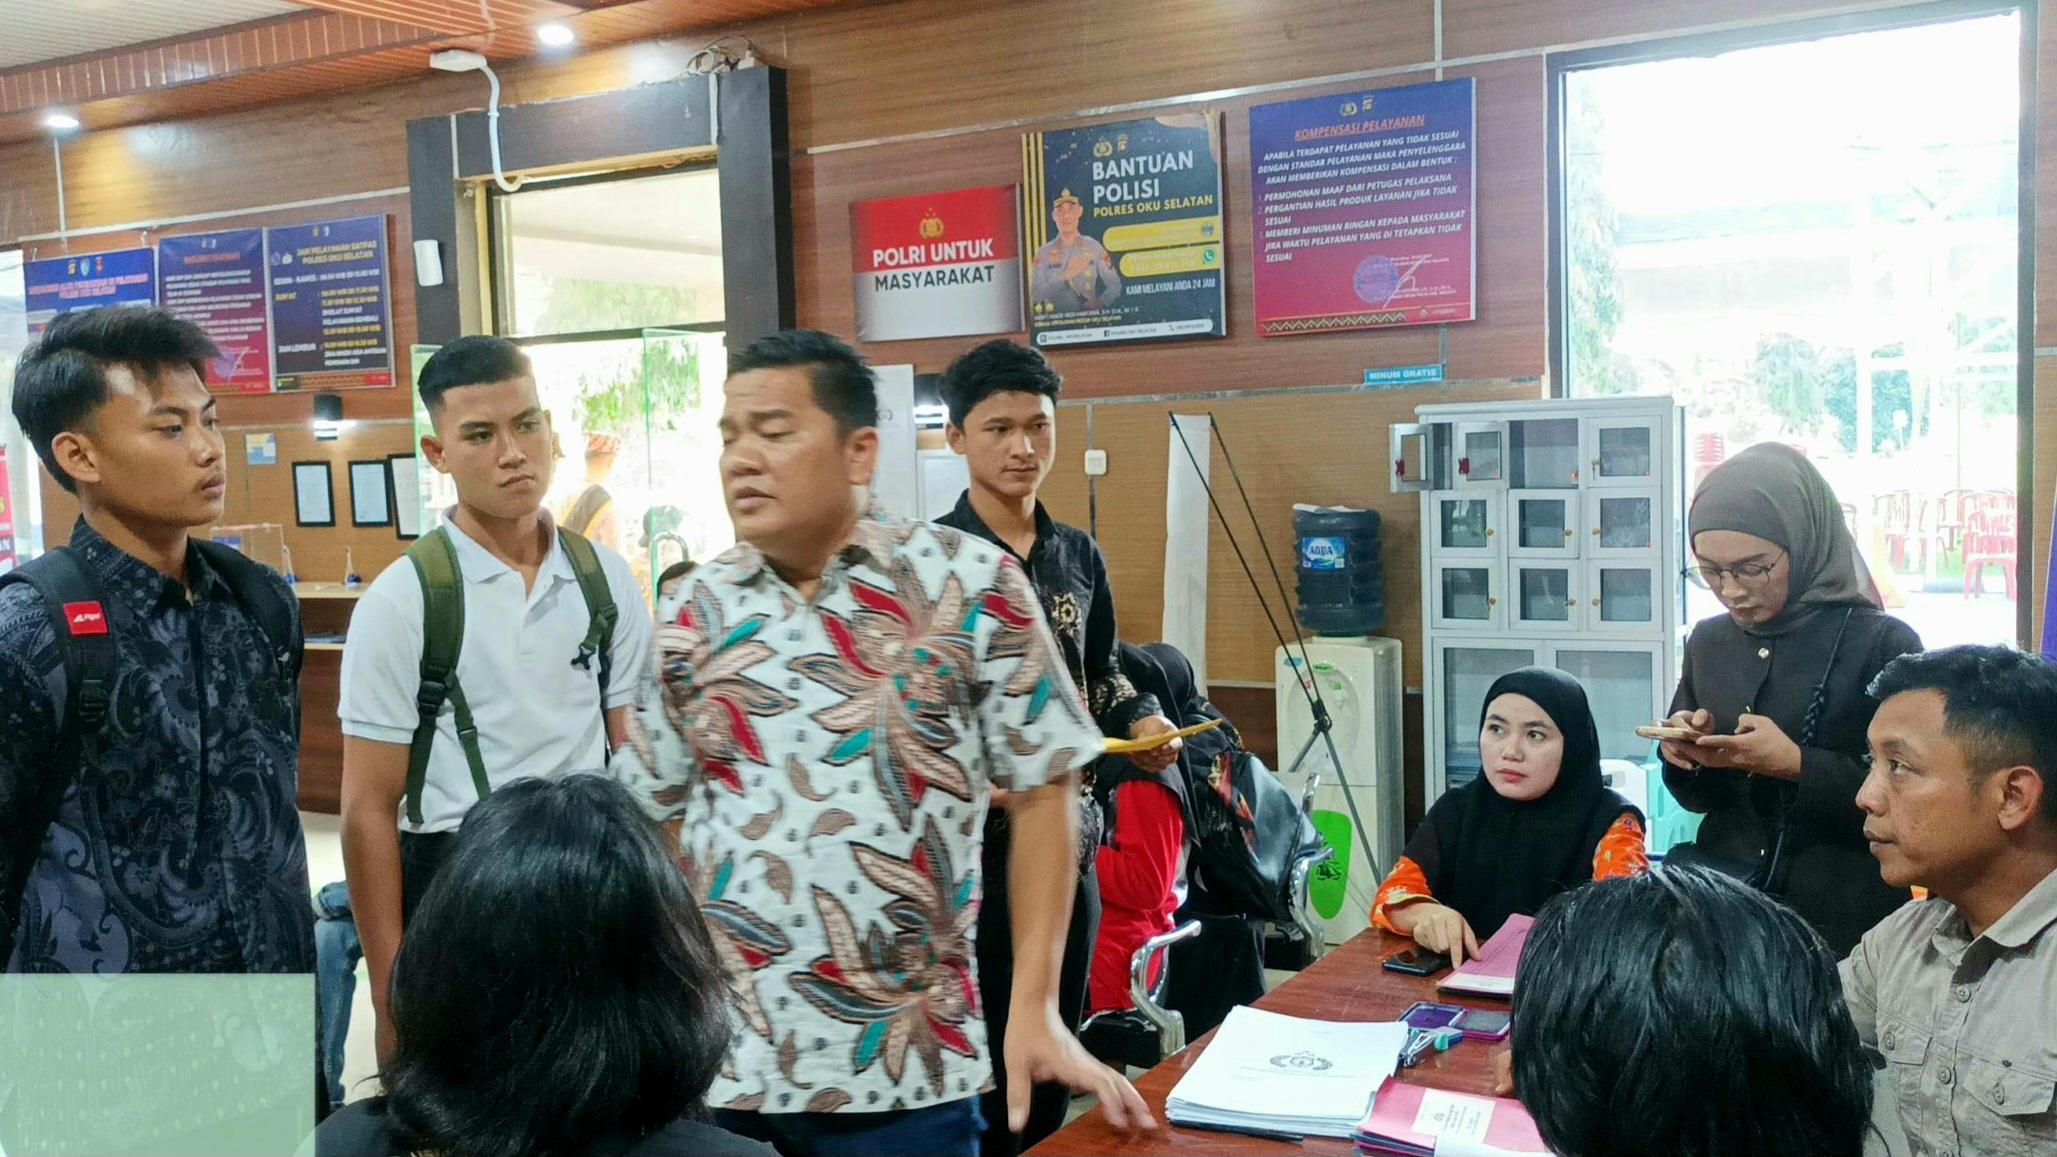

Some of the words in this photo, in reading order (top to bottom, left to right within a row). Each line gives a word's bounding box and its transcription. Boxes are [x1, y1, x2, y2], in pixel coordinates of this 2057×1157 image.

[1295, 123, 1361, 141] KOMPENSASI
[1362, 115, 1425, 132] PELAYANAN
[1258, 163, 1290, 174] DENGAN
[1291, 159, 1325, 170] STANDAR
[1327, 153, 1372, 166] PELAYANAN
[1374, 150, 1396, 159] MAKA
[1398, 142, 1466, 157] PENYELENGGARA
[1264, 150, 1294, 161] APABILA
[1296, 145, 1334, 157] TERDAPAT
[1335, 140, 1380, 152] PELAYANAN
[1382, 137, 1404, 147] YANG
[1406, 134, 1429, 143] TIDAK
[1431, 130, 1459, 140] SESUAI
[1092, 149, 1194, 181] BANTUAN
[1266, 176, 1286, 185] AKAN
[1288, 170, 1338, 182] MEMBERIKAN
[1340, 164, 1389, 177] KOMPENSASI
[1391, 160, 1418, 171] DALAM
[1421, 157, 1453, 167] BENTUK
[1093, 178, 1160, 204] POLISI
[1265, 188, 1320, 201] PERMOHONAN
[1322, 186, 1344, 195] MAAF
[1346, 183, 1365, 192] DARI
[1367, 179, 1402, 190] PETUGAS
[1404, 173, 1452, 186] PELAKSANA
[1265, 202, 1313, 213] PERGANTIAN
[1315, 199, 1337, 209] HASIL
[1339, 195, 1372, 206] PRODUK
[1374, 191, 1412, 202] LAYANAN
[1413, 188, 1430, 199] JIKA
[1433, 185, 1457, 196] TIDAK
[1093, 200, 1134, 218] POLRES
[1137, 198, 1161, 213] OKU
[1164, 195, 1213, 210] SELATAN
[1265, 216, 1292, 226] SESUAI
[1265, 227, 1300, 238] MEMBERI
[1302, 223, 1342, 234] MINUMAN
[1344, 219, 1375, 230] RINGAN
[1378, 216, 1408, 226] KEPADA
[1411, 210, 1465, 223] MASYARAKAT
[1264, 242, 1281, 252] JIKA
[1283, 239, 1309, 249] WAKTU
[1311, 234, 1357, 246] PELAYANAN
[1360, 231, 1380, 241] YANG
[1383, 230, 1392, 239] DI
[1395, 226, 1435, 238] TETAPKAN
[1438, 223, 1462, 233] TIDAK
[872, 244, 926, 268] POLRI
[930, 238, 993, 262] UNTUK
[1266, 253, 1292, 263] SESUAI
[875, 265, 994, 292] MASYARAKAT
[1174, 280, 1191, 291] ANDA
[1192, 279, 1201, 289] 24
[1202, 278, 1216, 287] JAM
[1369, 371, 1400, 380] MINUM
[1403, 368, 1437, 378] GRATIS
[1309, 545, 1333, 556] AQUA
